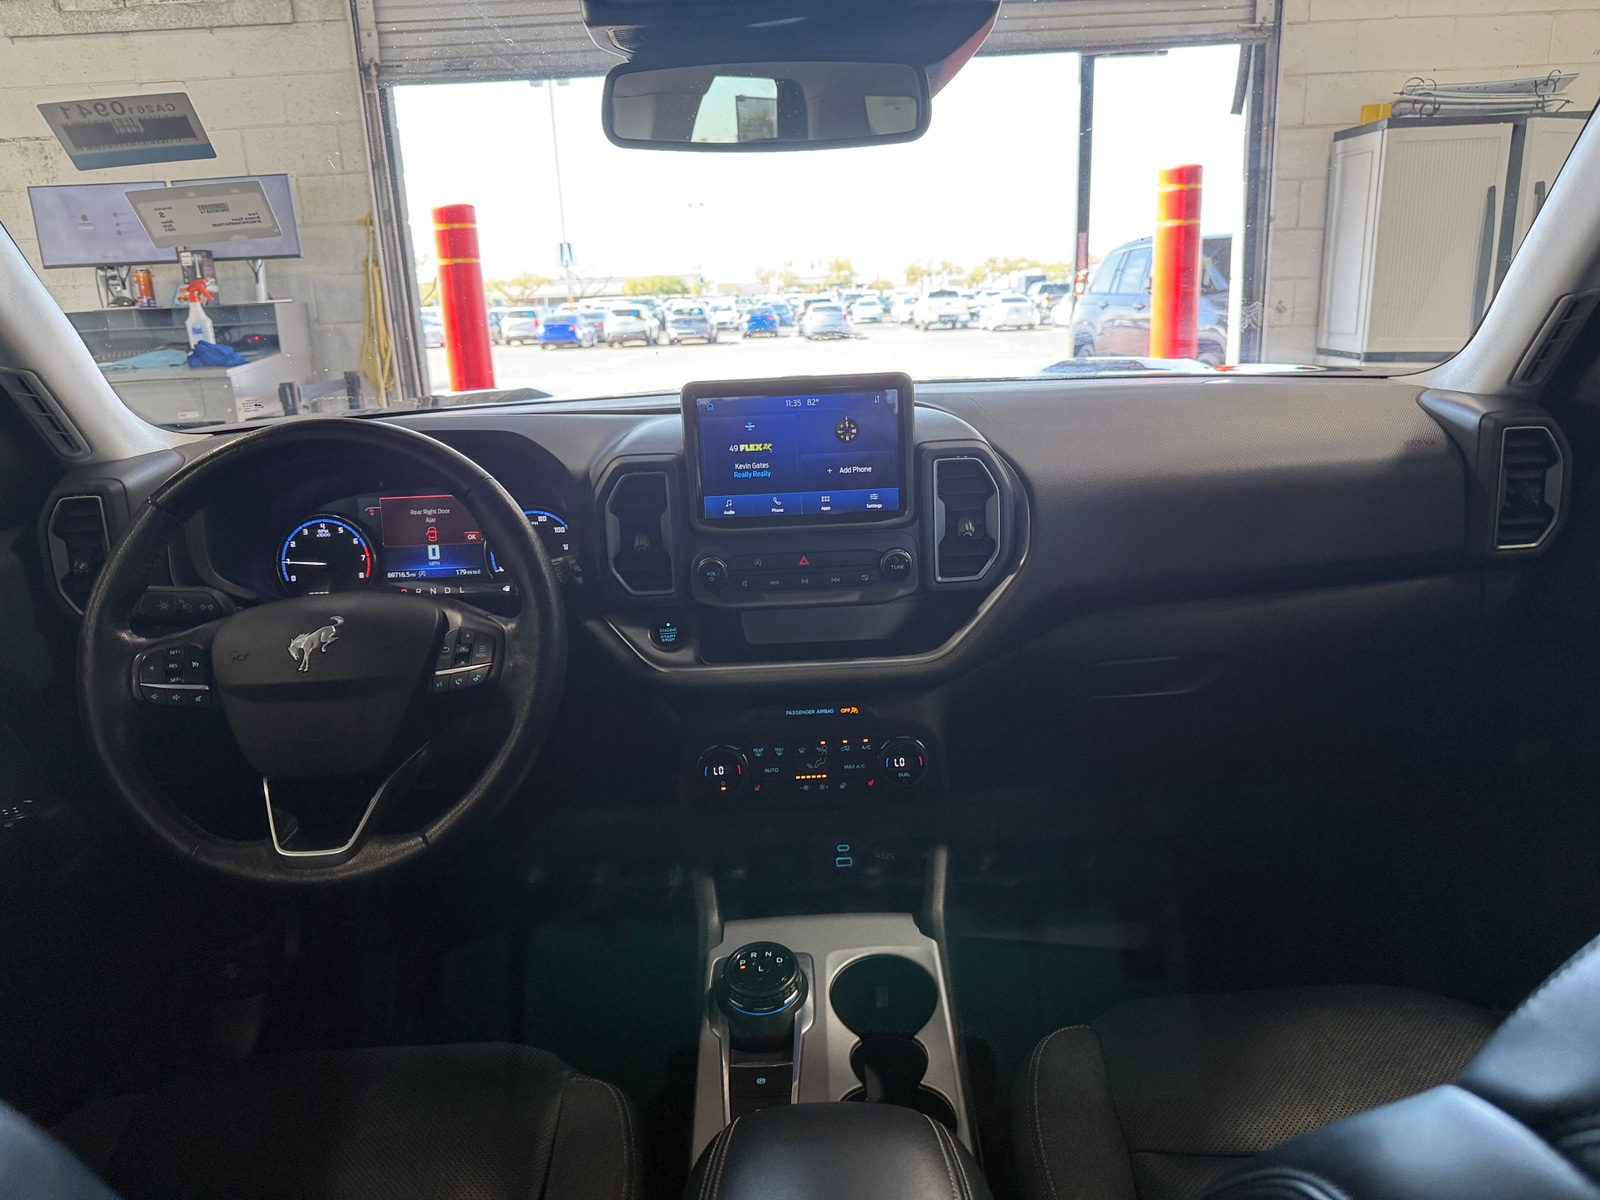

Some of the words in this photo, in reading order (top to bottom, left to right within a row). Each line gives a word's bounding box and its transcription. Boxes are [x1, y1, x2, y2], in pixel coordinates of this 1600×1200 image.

[807, 398, 820, 406] 82°
[427, 544, 440, 560] 0
[894, 757, 905, 767] LO
[713, 766, 724, 776] LO
